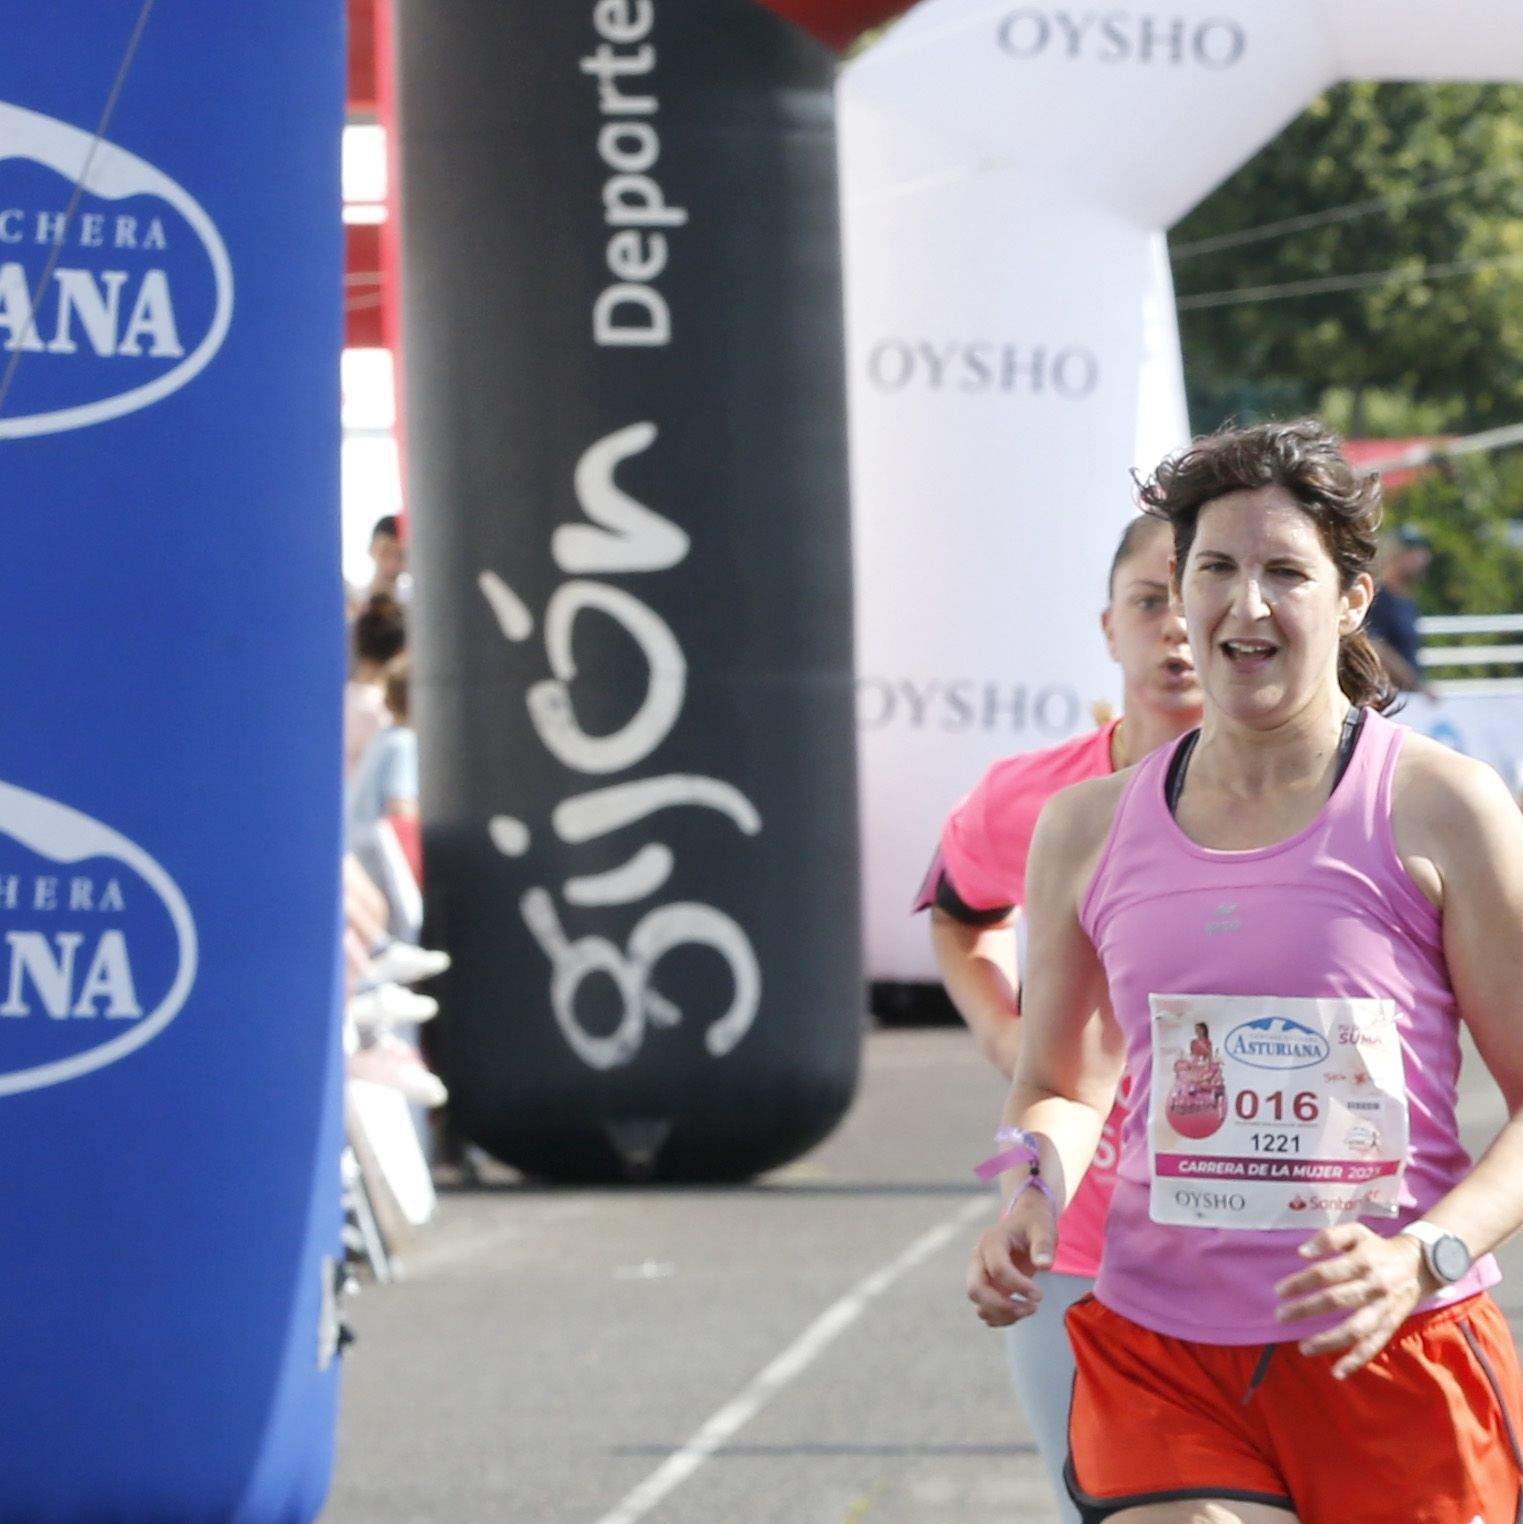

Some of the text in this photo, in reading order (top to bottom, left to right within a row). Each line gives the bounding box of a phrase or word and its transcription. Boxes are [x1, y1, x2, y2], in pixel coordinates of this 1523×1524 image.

[998, 8, 1246, 68] OYSHO
[579, 0, 689, 347] Deporte
[0, 262, 186, 358] ANA
[866, 340, 1100, 399] OYSHO
[855, 676, 1080, 736] OYSHO
[1233, 1034, 1322, 1058] ASTURIANA
[1235, 1089, 1319, 1122] 016
[1250, 1134, 1300, 1153] 1221
[1178, 1159, 1244, 1176] CARRERA
[1248, 1162, 1270, 1177] DE
[1271, 1164, 1292, 1178] LA
[1293, 1165, 1344, 1179] MUJER
[1174, 1189, 1246, 1212] OYSHO
